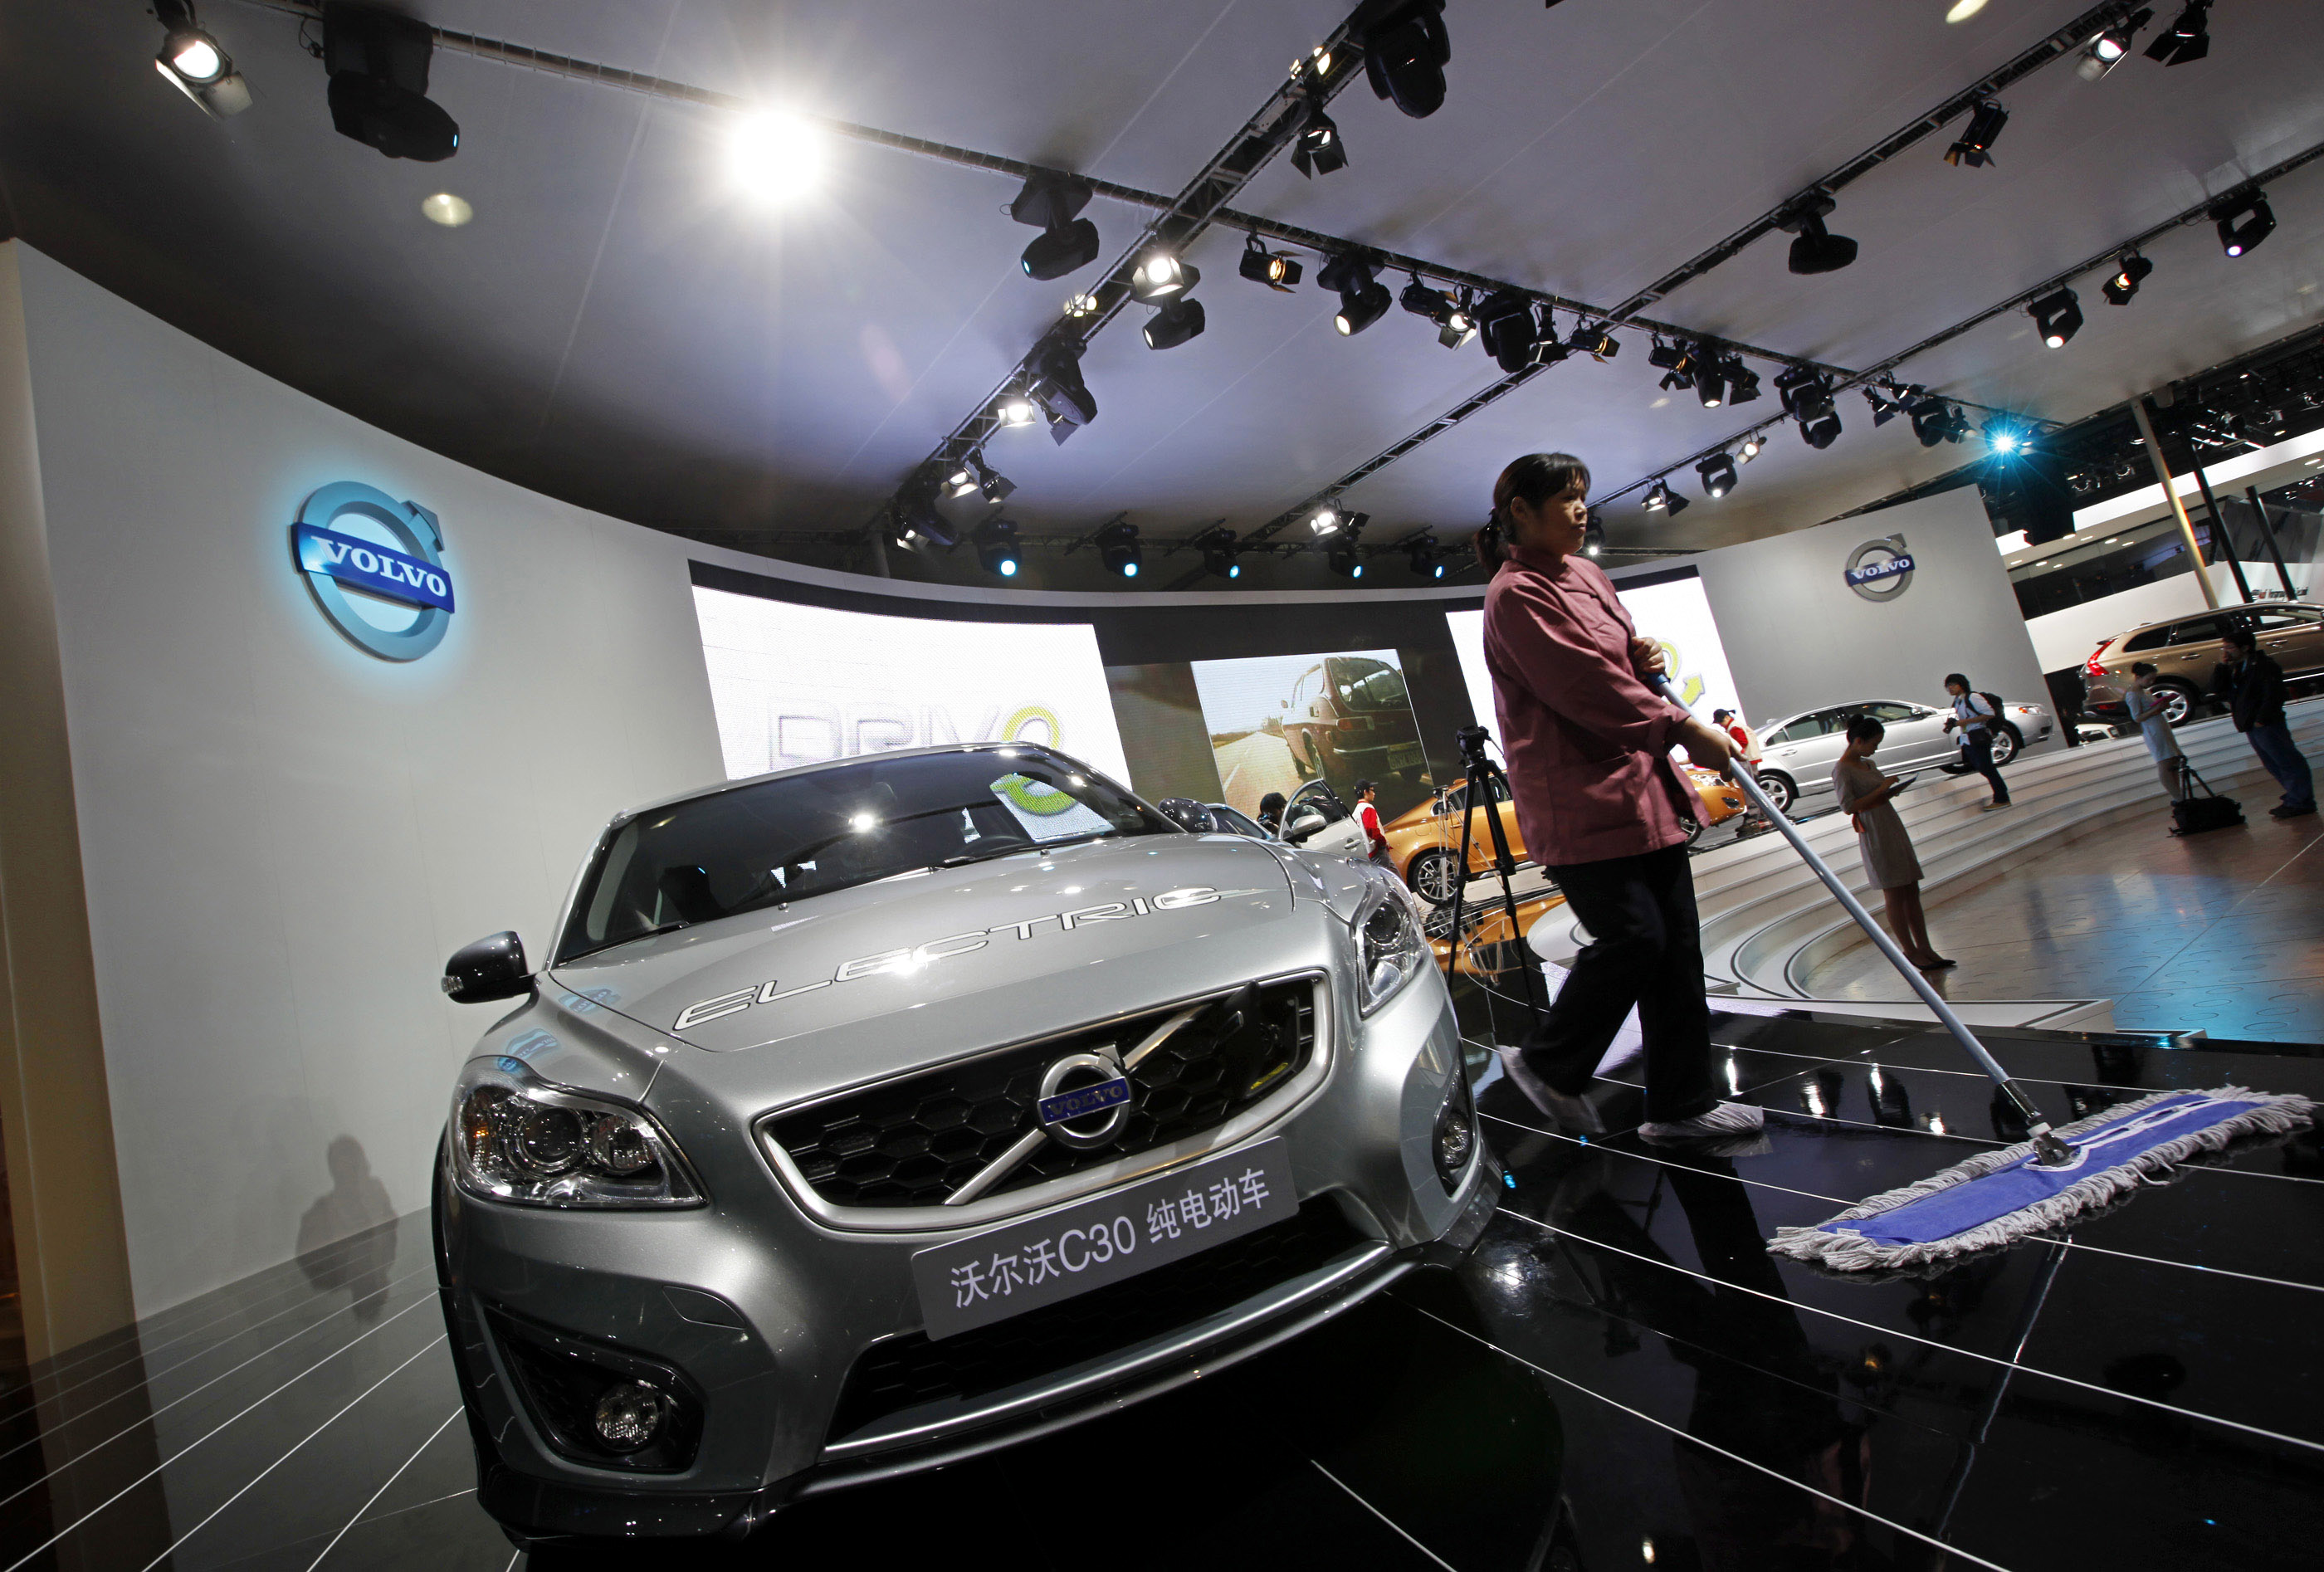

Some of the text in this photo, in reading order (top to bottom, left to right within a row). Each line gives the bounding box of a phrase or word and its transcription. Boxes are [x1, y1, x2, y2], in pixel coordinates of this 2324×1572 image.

[310, 535, 447, 597] VOLVO
[1851, 558, 1911, 579] VOLVO
[672, 887, 1222, 1031] ELECTRIC
[1048, 1086, 1123, 1116] VOLVO
[950, 1167, 1270, 1309] 沃尔沃C30 纯电动车
